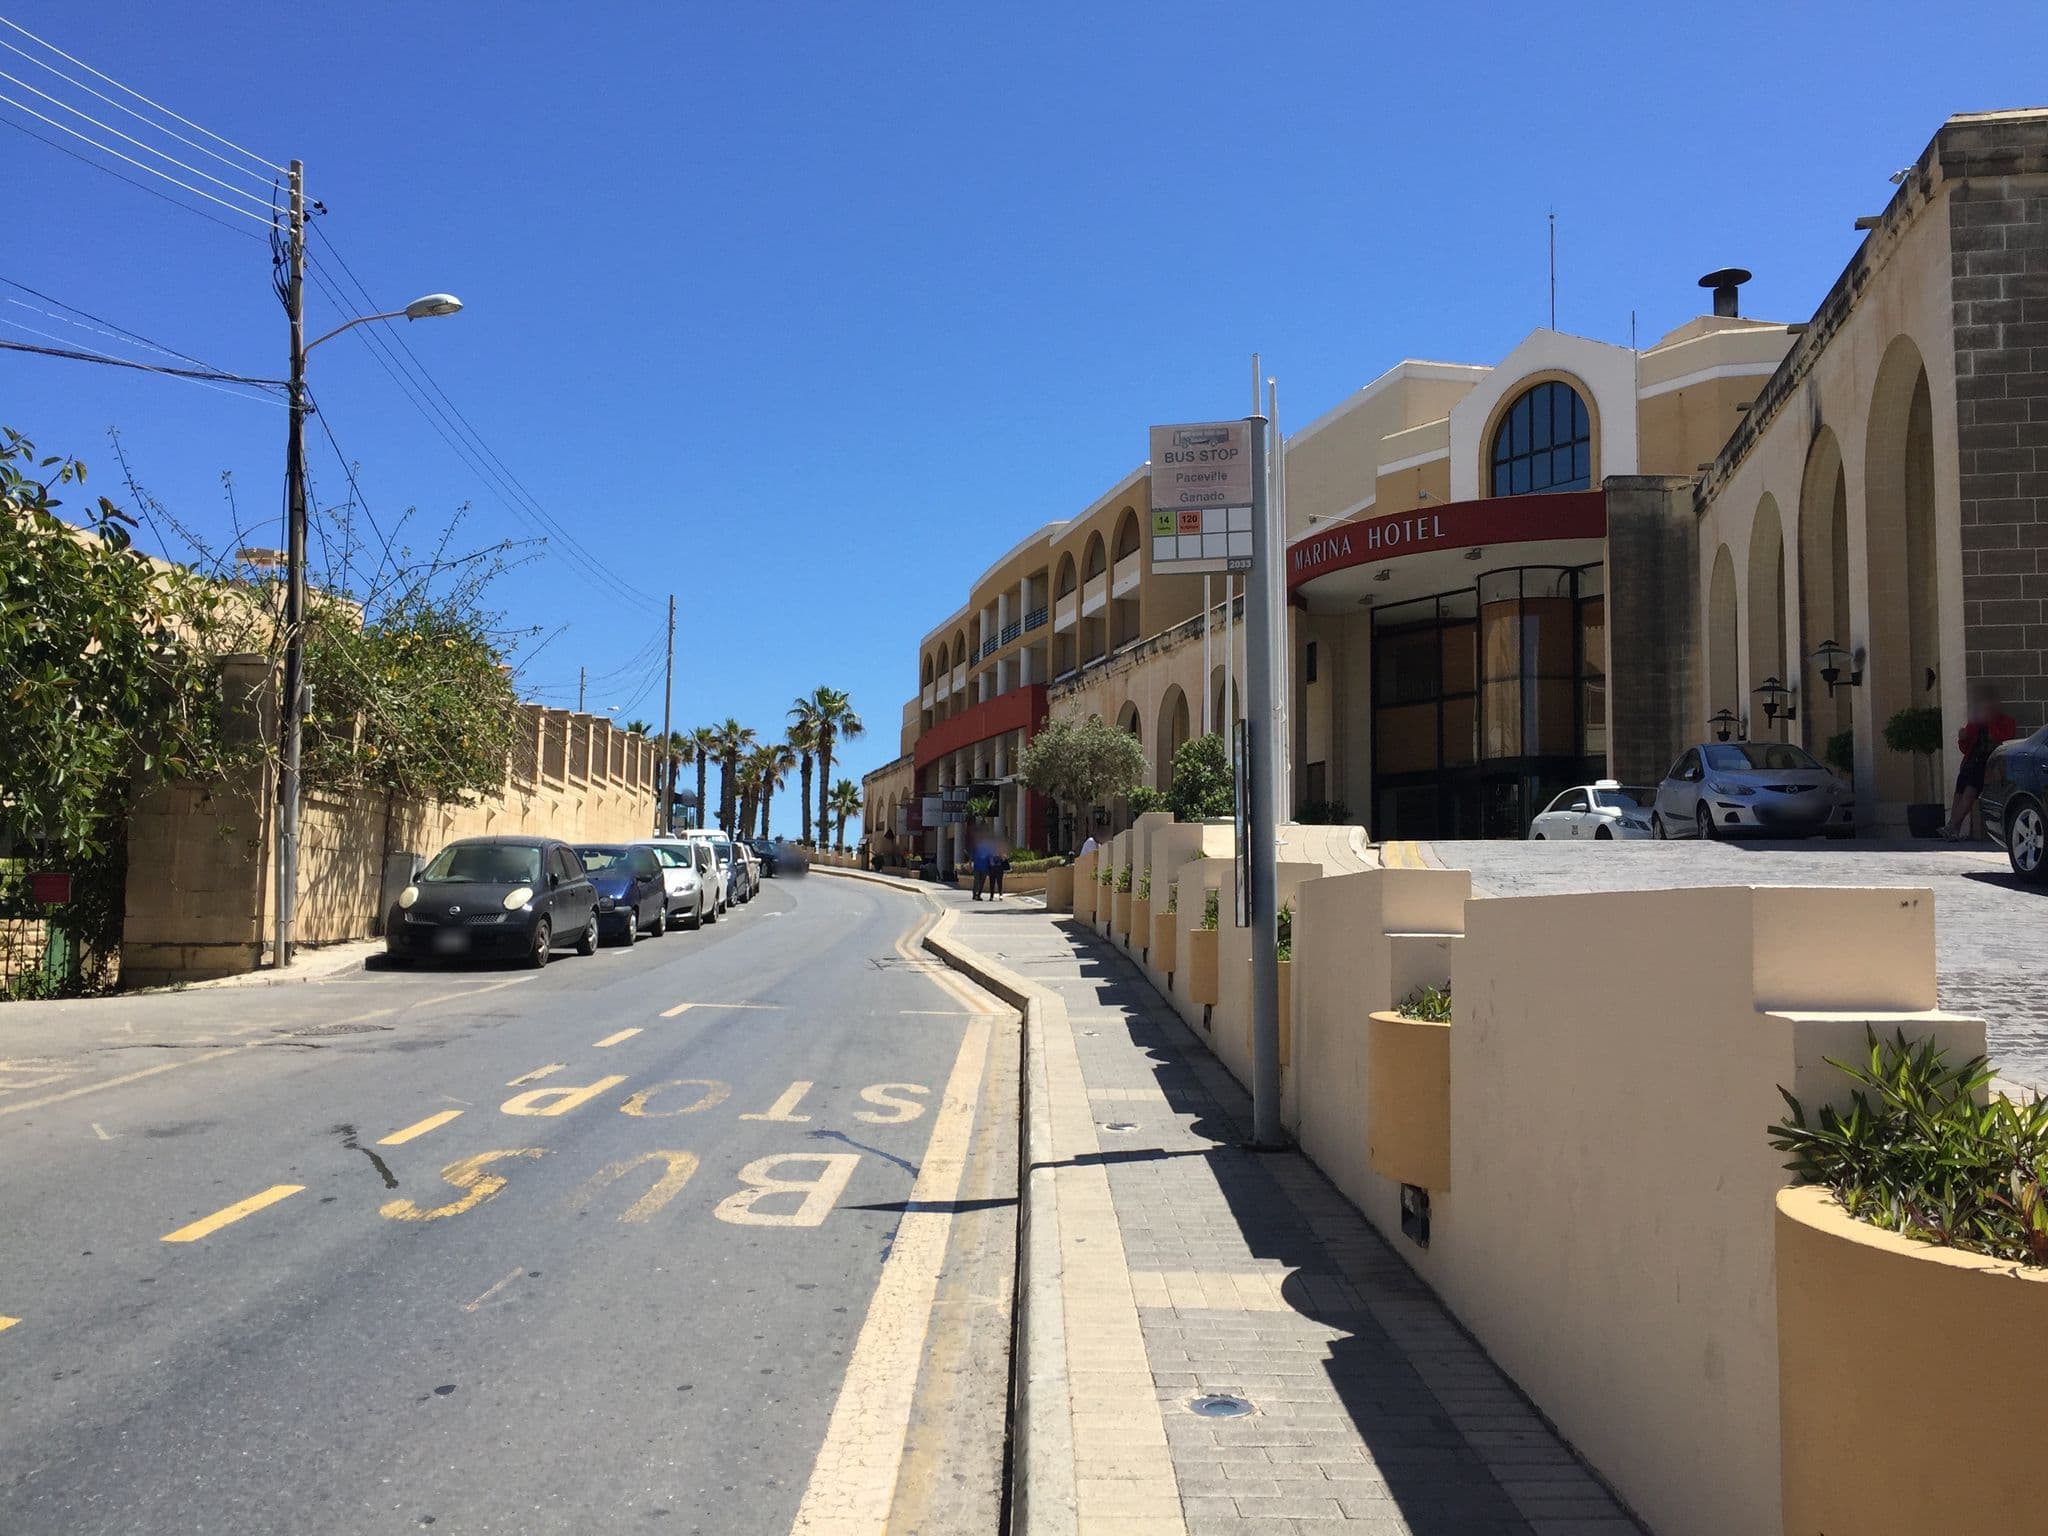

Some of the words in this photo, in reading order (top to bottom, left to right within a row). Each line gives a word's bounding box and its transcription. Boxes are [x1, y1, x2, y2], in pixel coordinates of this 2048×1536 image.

[1164, 451, 1195, 464] BUS
[1198, 448, 1238, 462] STOP
[1176, 471, 1228, 484] Paceville
[1180, 491, 1225, 503] Ganado
[1158, 516, 1170, 525] 14
[1181, 514, 1198, 524] 120
[1295, 535, 1352, 571] MARINA
[1368, 515, 1446, 549] HOTEL
[500, 1075, 931, 1124] STOP
[380, 1147, 861, 1229] BUS
